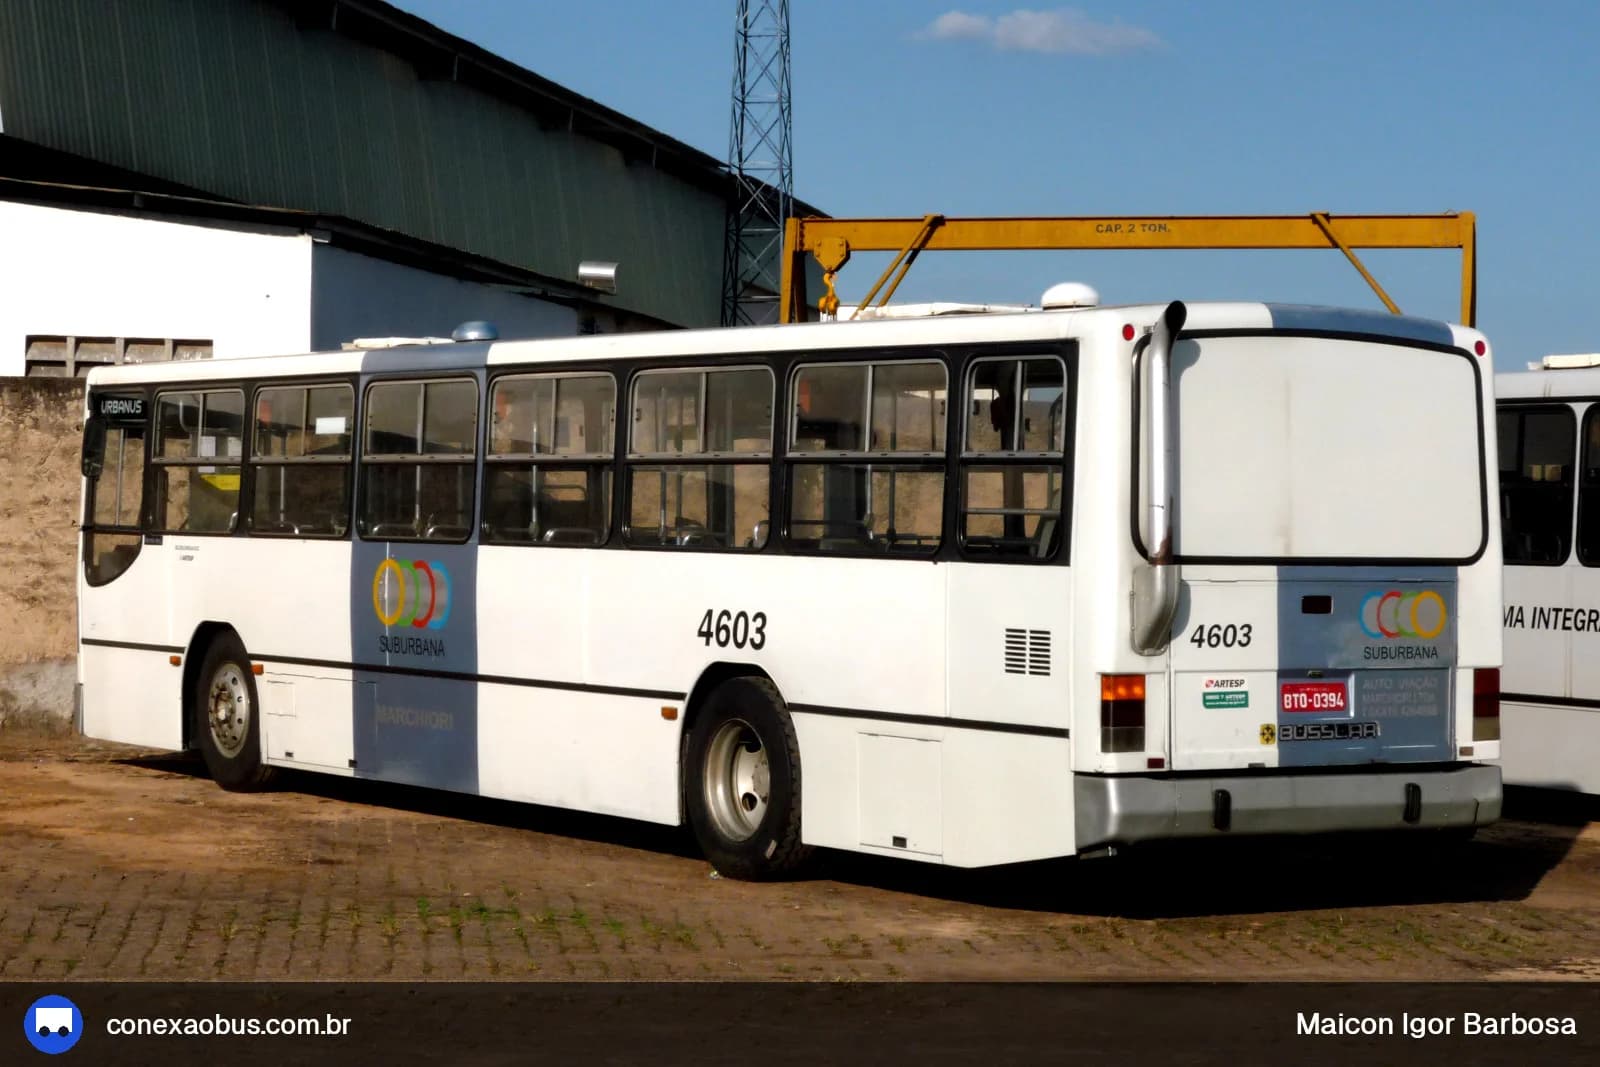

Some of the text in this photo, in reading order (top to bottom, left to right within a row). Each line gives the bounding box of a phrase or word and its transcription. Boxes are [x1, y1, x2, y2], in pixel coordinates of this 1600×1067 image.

[1096, 223, 1171, 233] CAP. 2 TON.
[101, 400, 143, 414] URBANUS
[1531, 606, 1600, 633] INTEGR
[697, 608, 767, 651] 4603
[1190, 623, 1253, 648] 4603
[379, 635, 446, 657] SUBURBANA
[1363, 645, 1439, 660] SUBURBANA
[1213, 679, 1246, 688] ARTESP
[1283, 692, 1344, 709] BTO-0394
